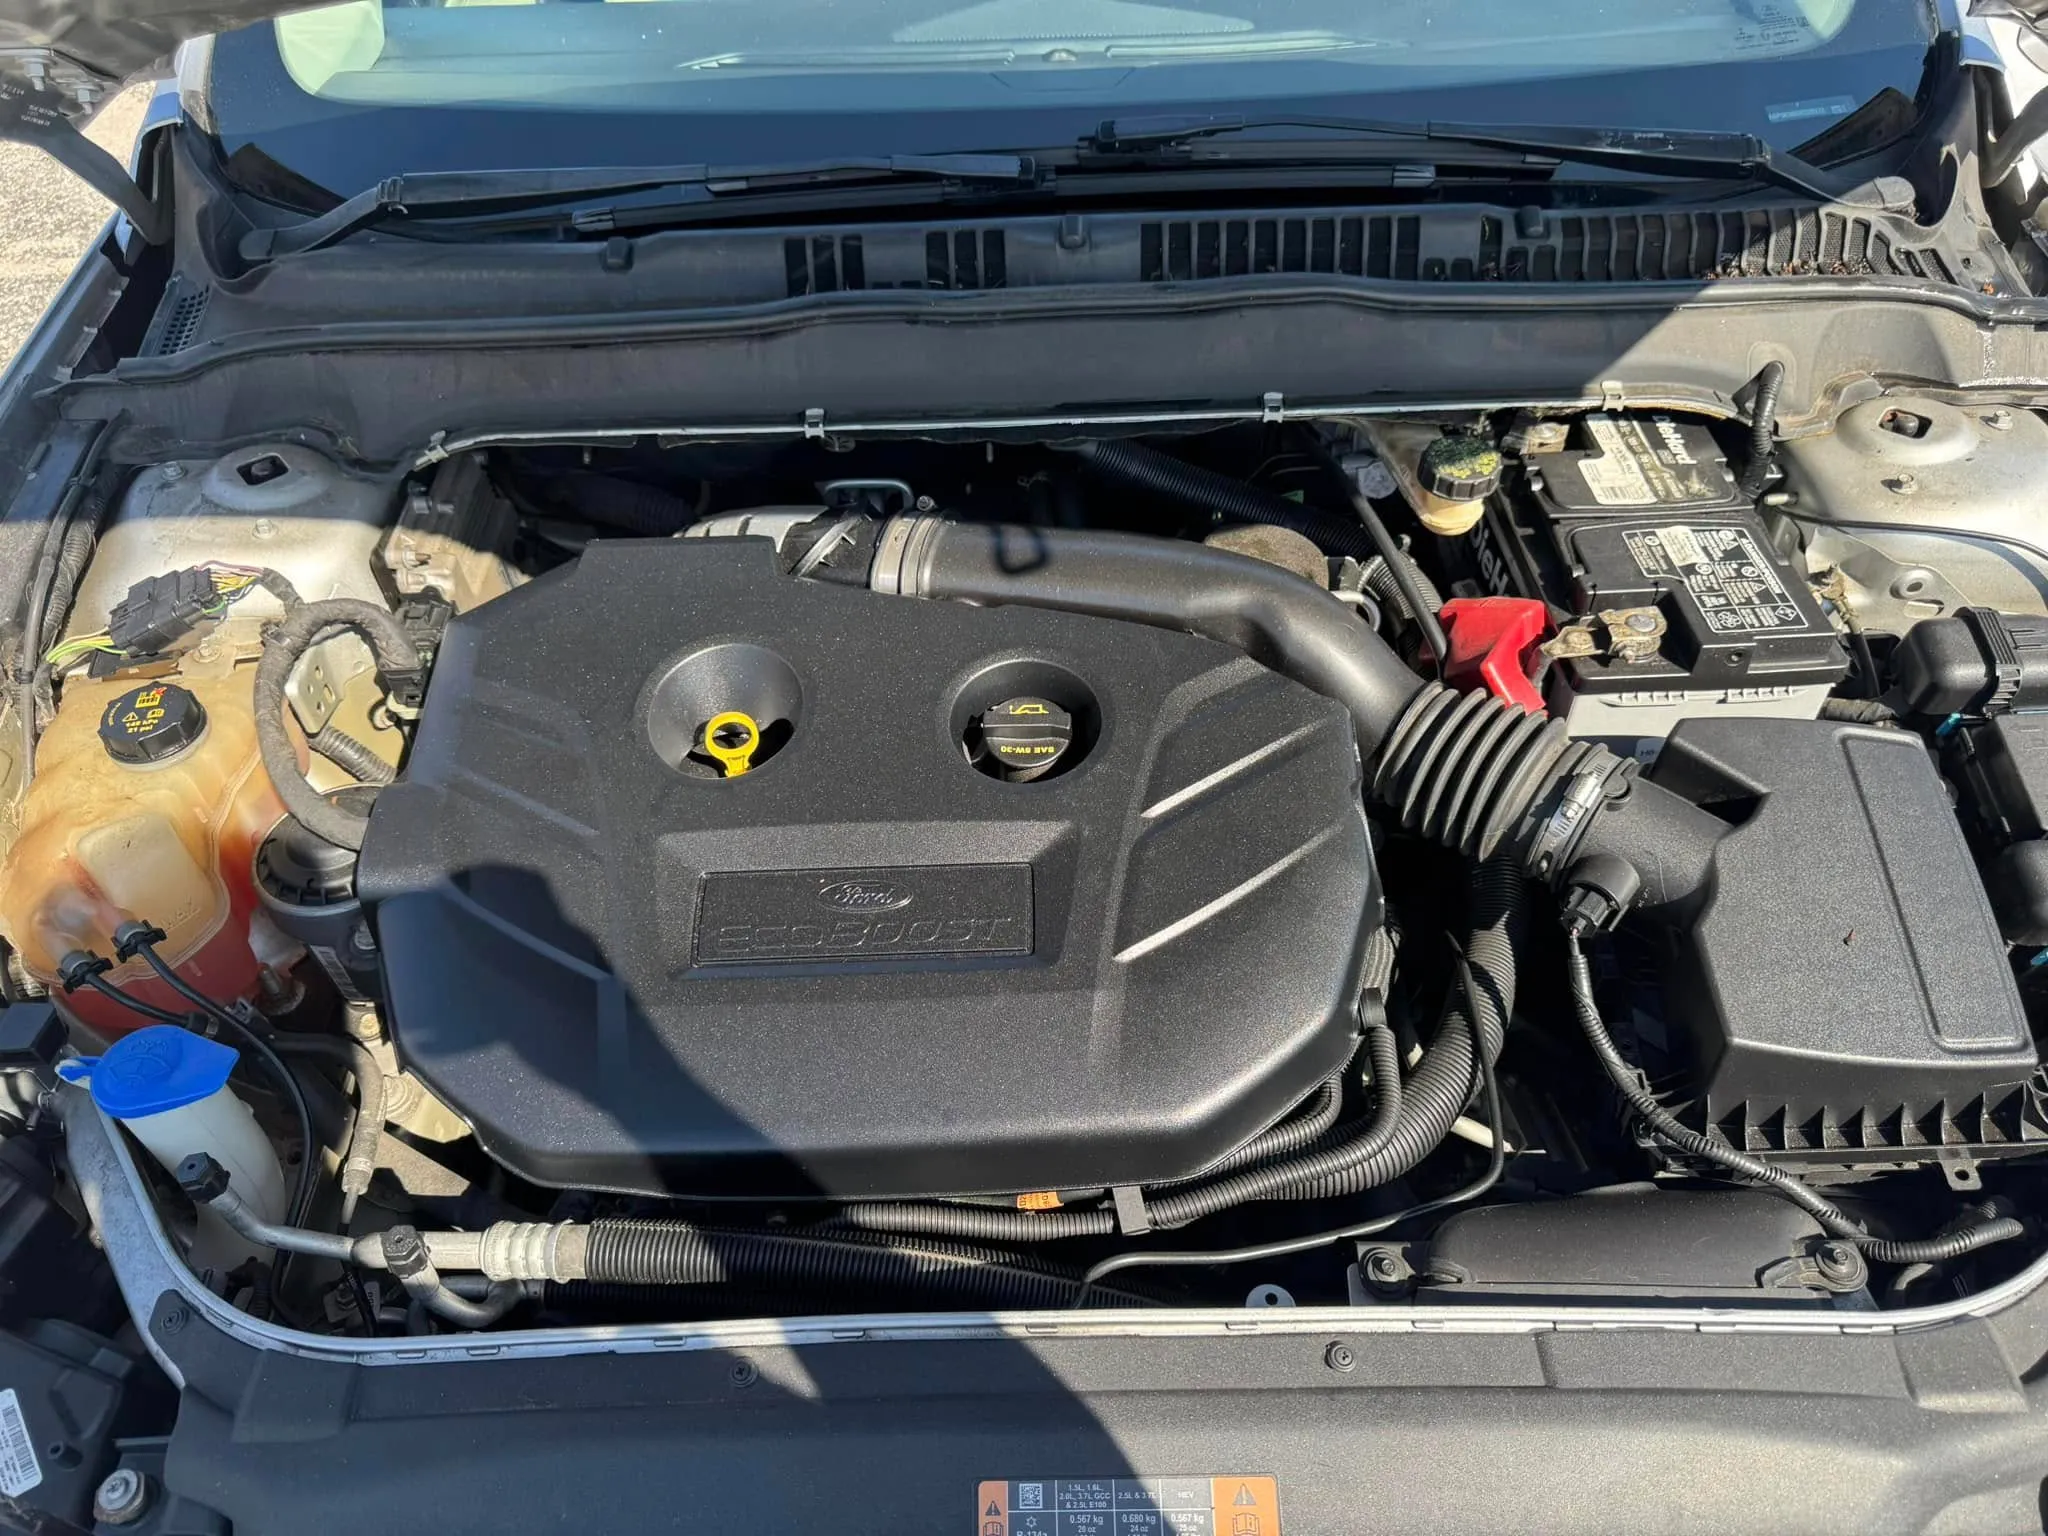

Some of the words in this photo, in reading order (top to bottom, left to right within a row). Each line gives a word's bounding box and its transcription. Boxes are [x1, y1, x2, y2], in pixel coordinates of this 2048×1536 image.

[1652, 415, 1697, 465] DieHard
[1033, 745, 1055, 754] SAE
[834, 884, 895, 906] Ford
[718, 916, 1013, 952] ECOBOOST
[1118, 1491, 1133, 1499] 2.5L
[1134, 1491, 1140, 1499] &
[1069, 1514, 1091, 1524] 0.567
[1093, 1514, 1104, 1526] kg
[1122, 1513, 1143, 1523] 0.680
[1145, 1513, 1156, 1525] kg
[1193, 1513, 1205, 1525] kg
